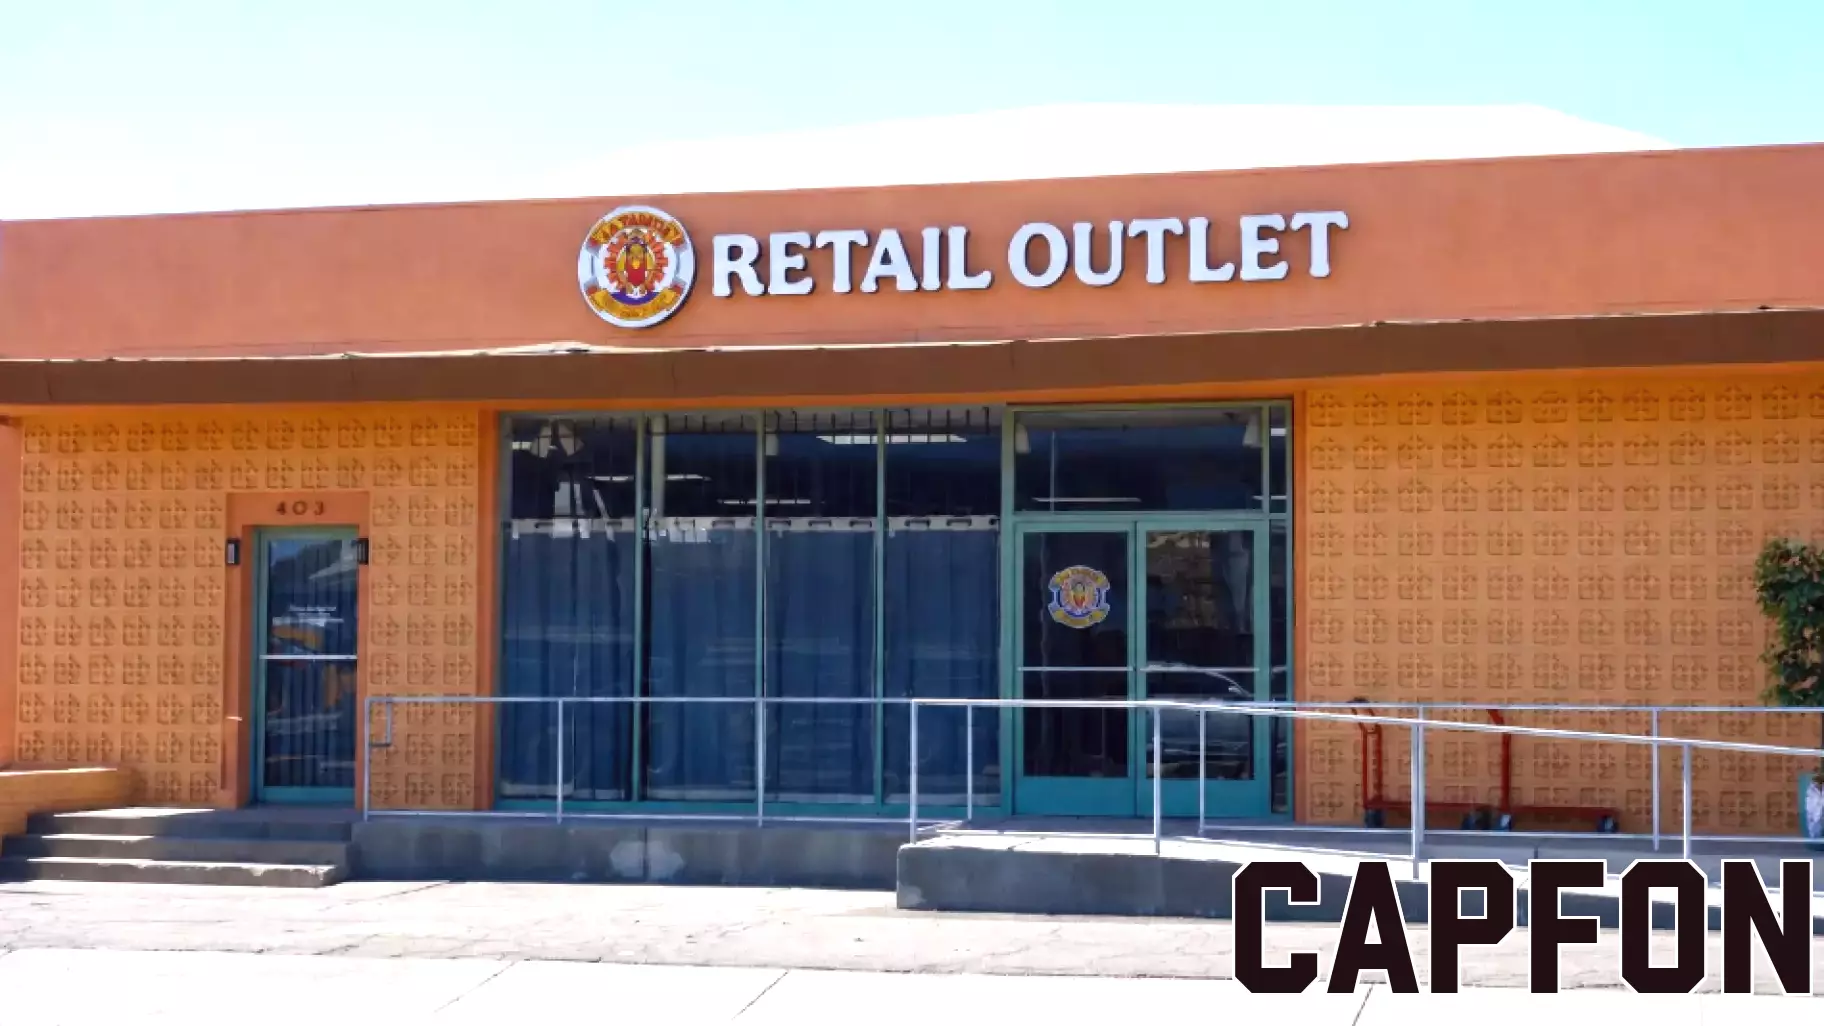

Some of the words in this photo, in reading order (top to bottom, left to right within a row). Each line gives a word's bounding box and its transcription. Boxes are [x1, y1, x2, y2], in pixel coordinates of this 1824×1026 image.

[711, 226, 992, 297] RETAIL
[1007, 211, 1349, 288] OUTLET
[276, 500, 325, 516] 403
